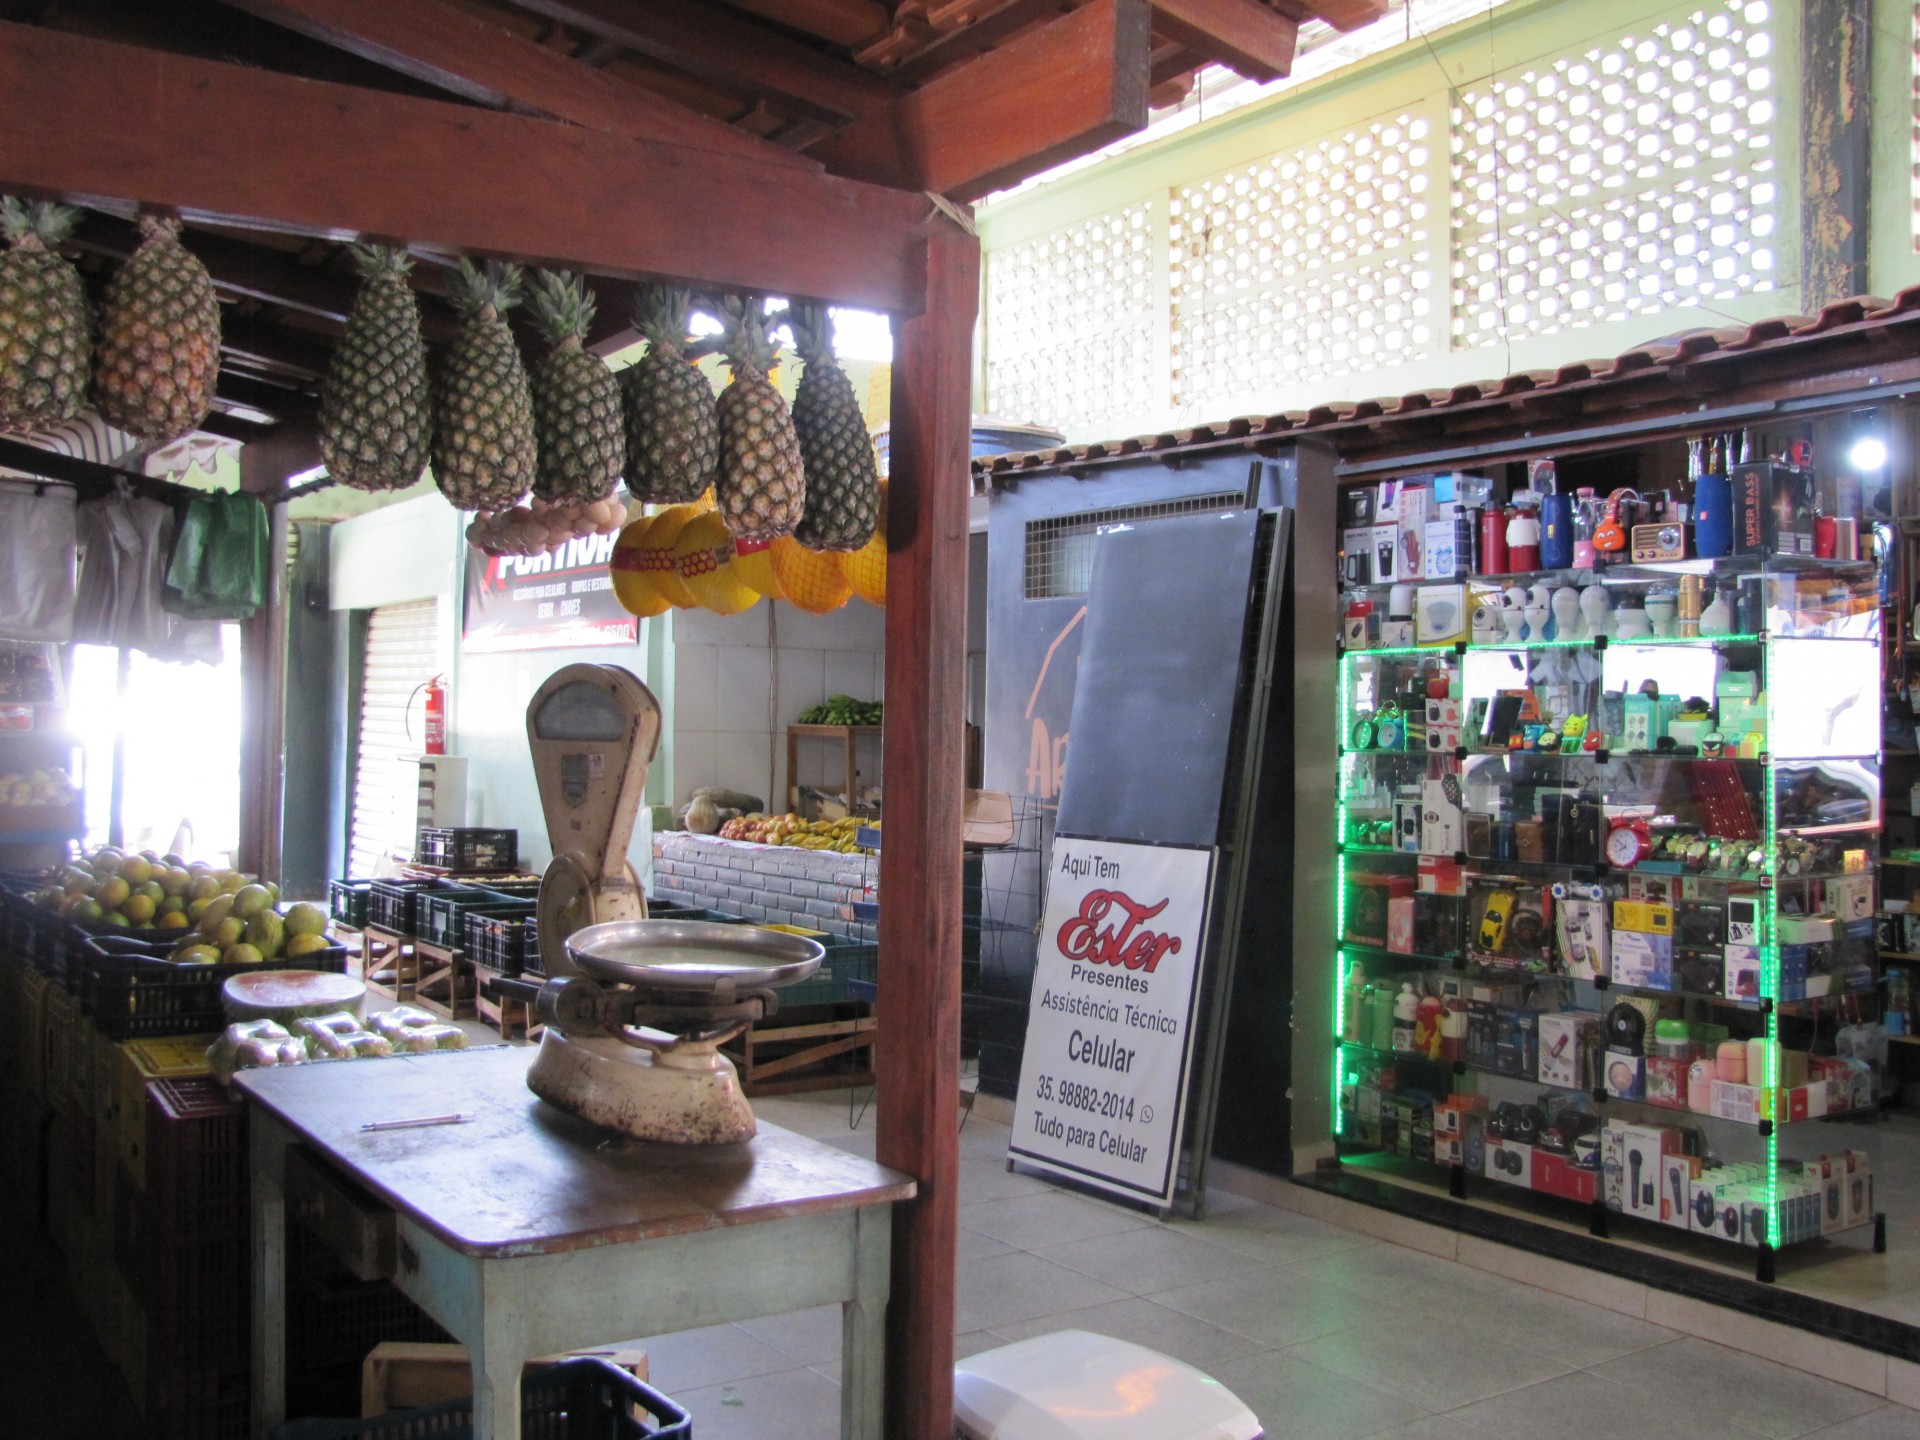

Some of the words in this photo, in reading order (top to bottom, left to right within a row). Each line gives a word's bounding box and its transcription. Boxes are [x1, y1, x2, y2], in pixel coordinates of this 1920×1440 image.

[1745, 472, 1755, 505] BASS
[1746, 508, 1756, 547] SUPER
[560, 598, 581, 616] CHAVES
[1061, 852, 1091, 880] Aqui
[1094, 856, 1120, 880] Tem
[1070, 963, 1149, 994] Presentes
[1041, 988, 1119, 1023] Assistência
[1125, 1004, 1178, 1036] Técnica
[1068, 1029, 1135, 1074] Celular
[1036, 1074, 1055, 1102] 35.
[1058, 1080, 1135, 1123] 98882-2014
[1034, 1110, 1064, 1139] Tudo
[1066, 1124, 1096, 1149] para
[1099, 1129, 1148, 1164] Celular
